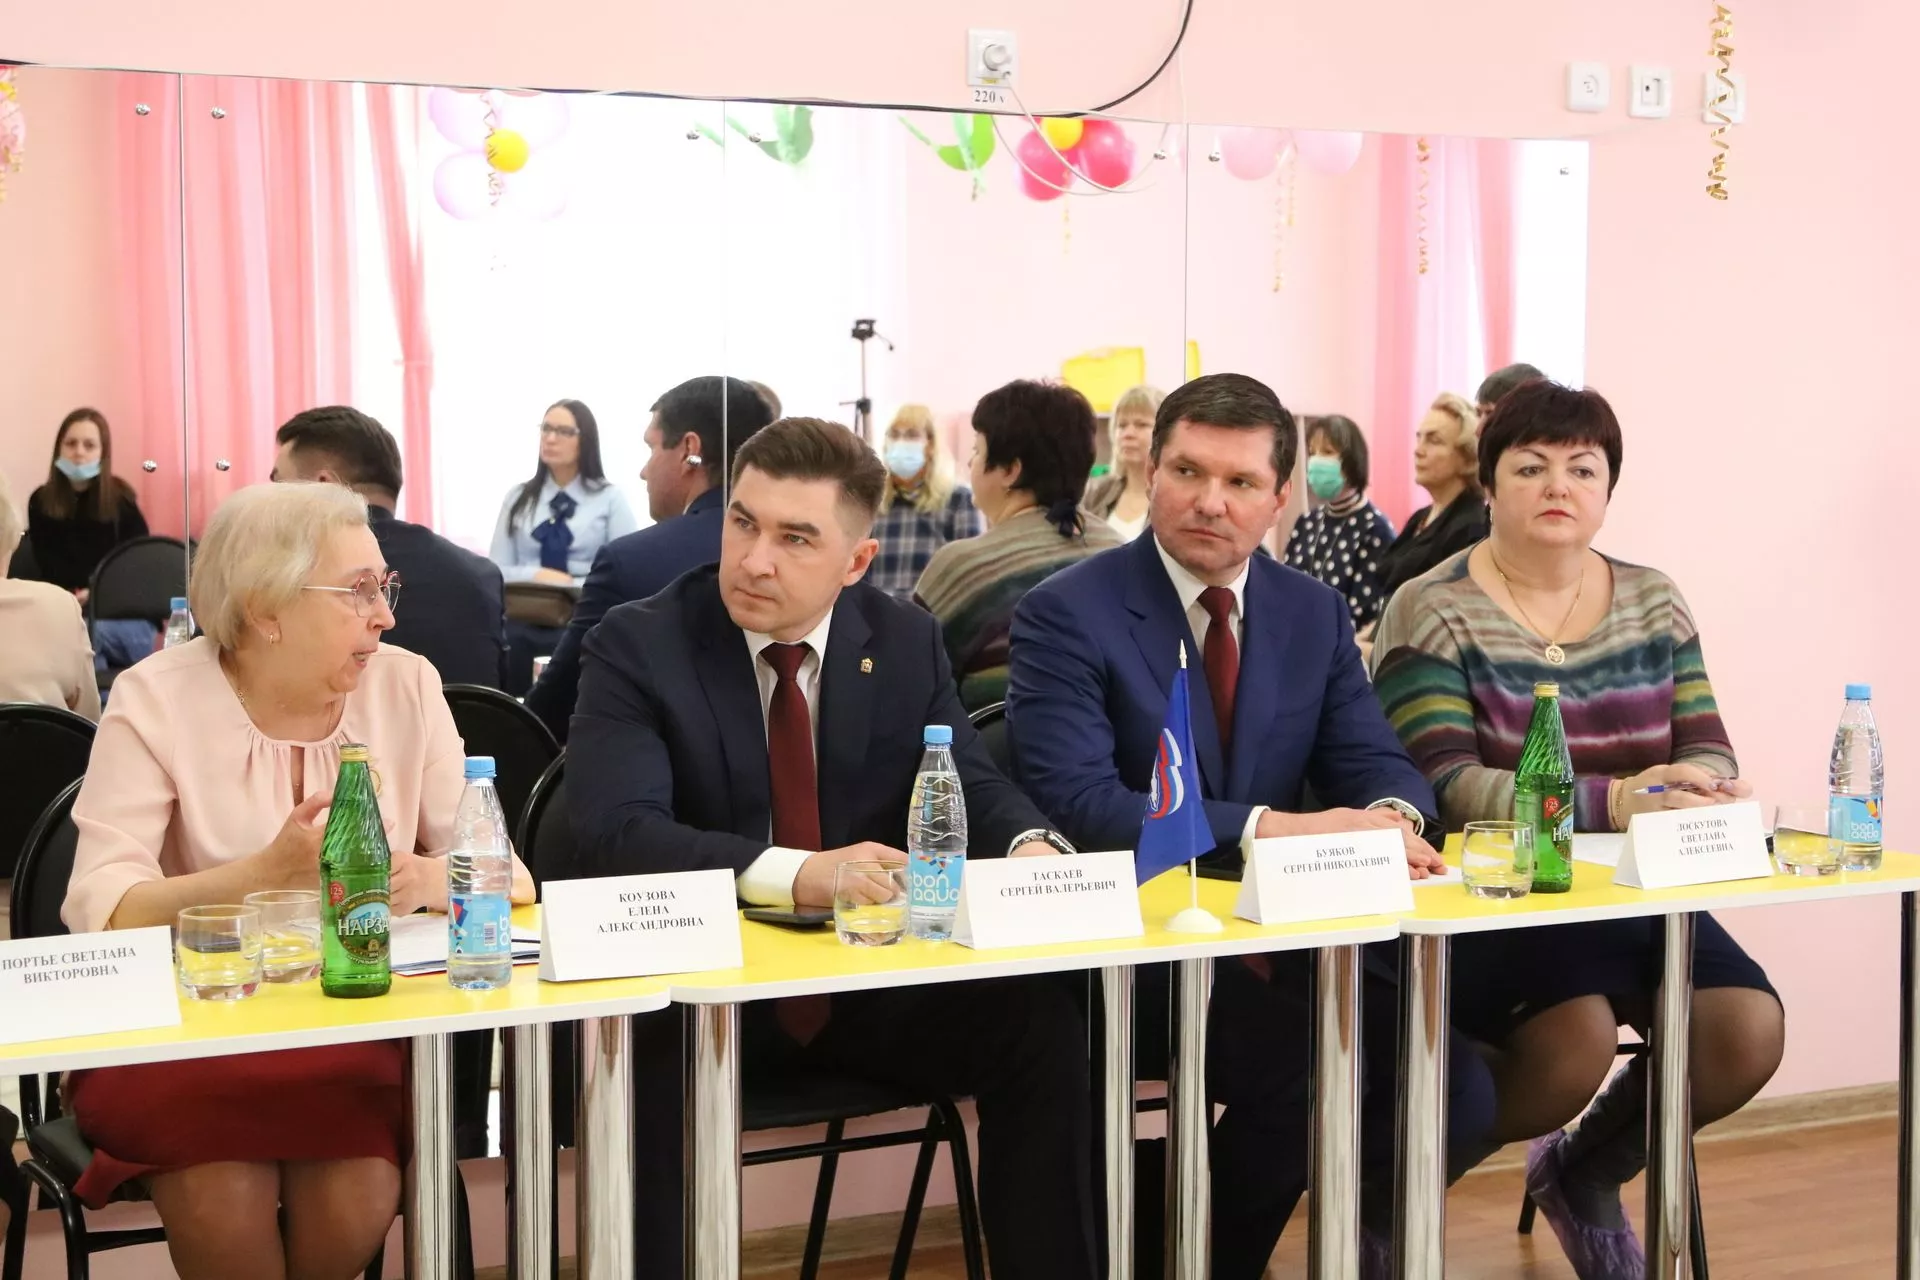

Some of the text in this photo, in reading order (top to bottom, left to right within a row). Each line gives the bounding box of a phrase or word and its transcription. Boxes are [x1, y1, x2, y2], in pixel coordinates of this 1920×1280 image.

[974, 90, 996, 103] 220
[1677, 819, 1728, 832] ЛОСКУТОВА
[1681, 831, 1727, 844] СВЕТЛАНА
[1316, 846, 1356, 858] БУЯКОВ
[1678, 842, 1734, 856] АЛЕКСЕЕВНА
[1283, 856, 1390, 874] СЕРГЕЙ НИКОЛАЕВИЧ
[913, 870, 949, 889] bon
[1032, 869, 1083, 881] ТАСКАЕВ
[330, 886, 343, 896] 125
[1000, 880, 1116, 897] СЕРГЕЙ ВАЛЕРЬЕВИЧ
[619, 890, 676, 903] КОУЗОВА
[628, 905, 669, 917] ЕЛЕНА
[597, 917, 704, 934] АЛЕКСАНДРОВНА
[2, 947, 137, 970] ПОРТЬЕ СВЕТЛАНА
[23, 965, 119, 984] ВИКТОРОВНА
